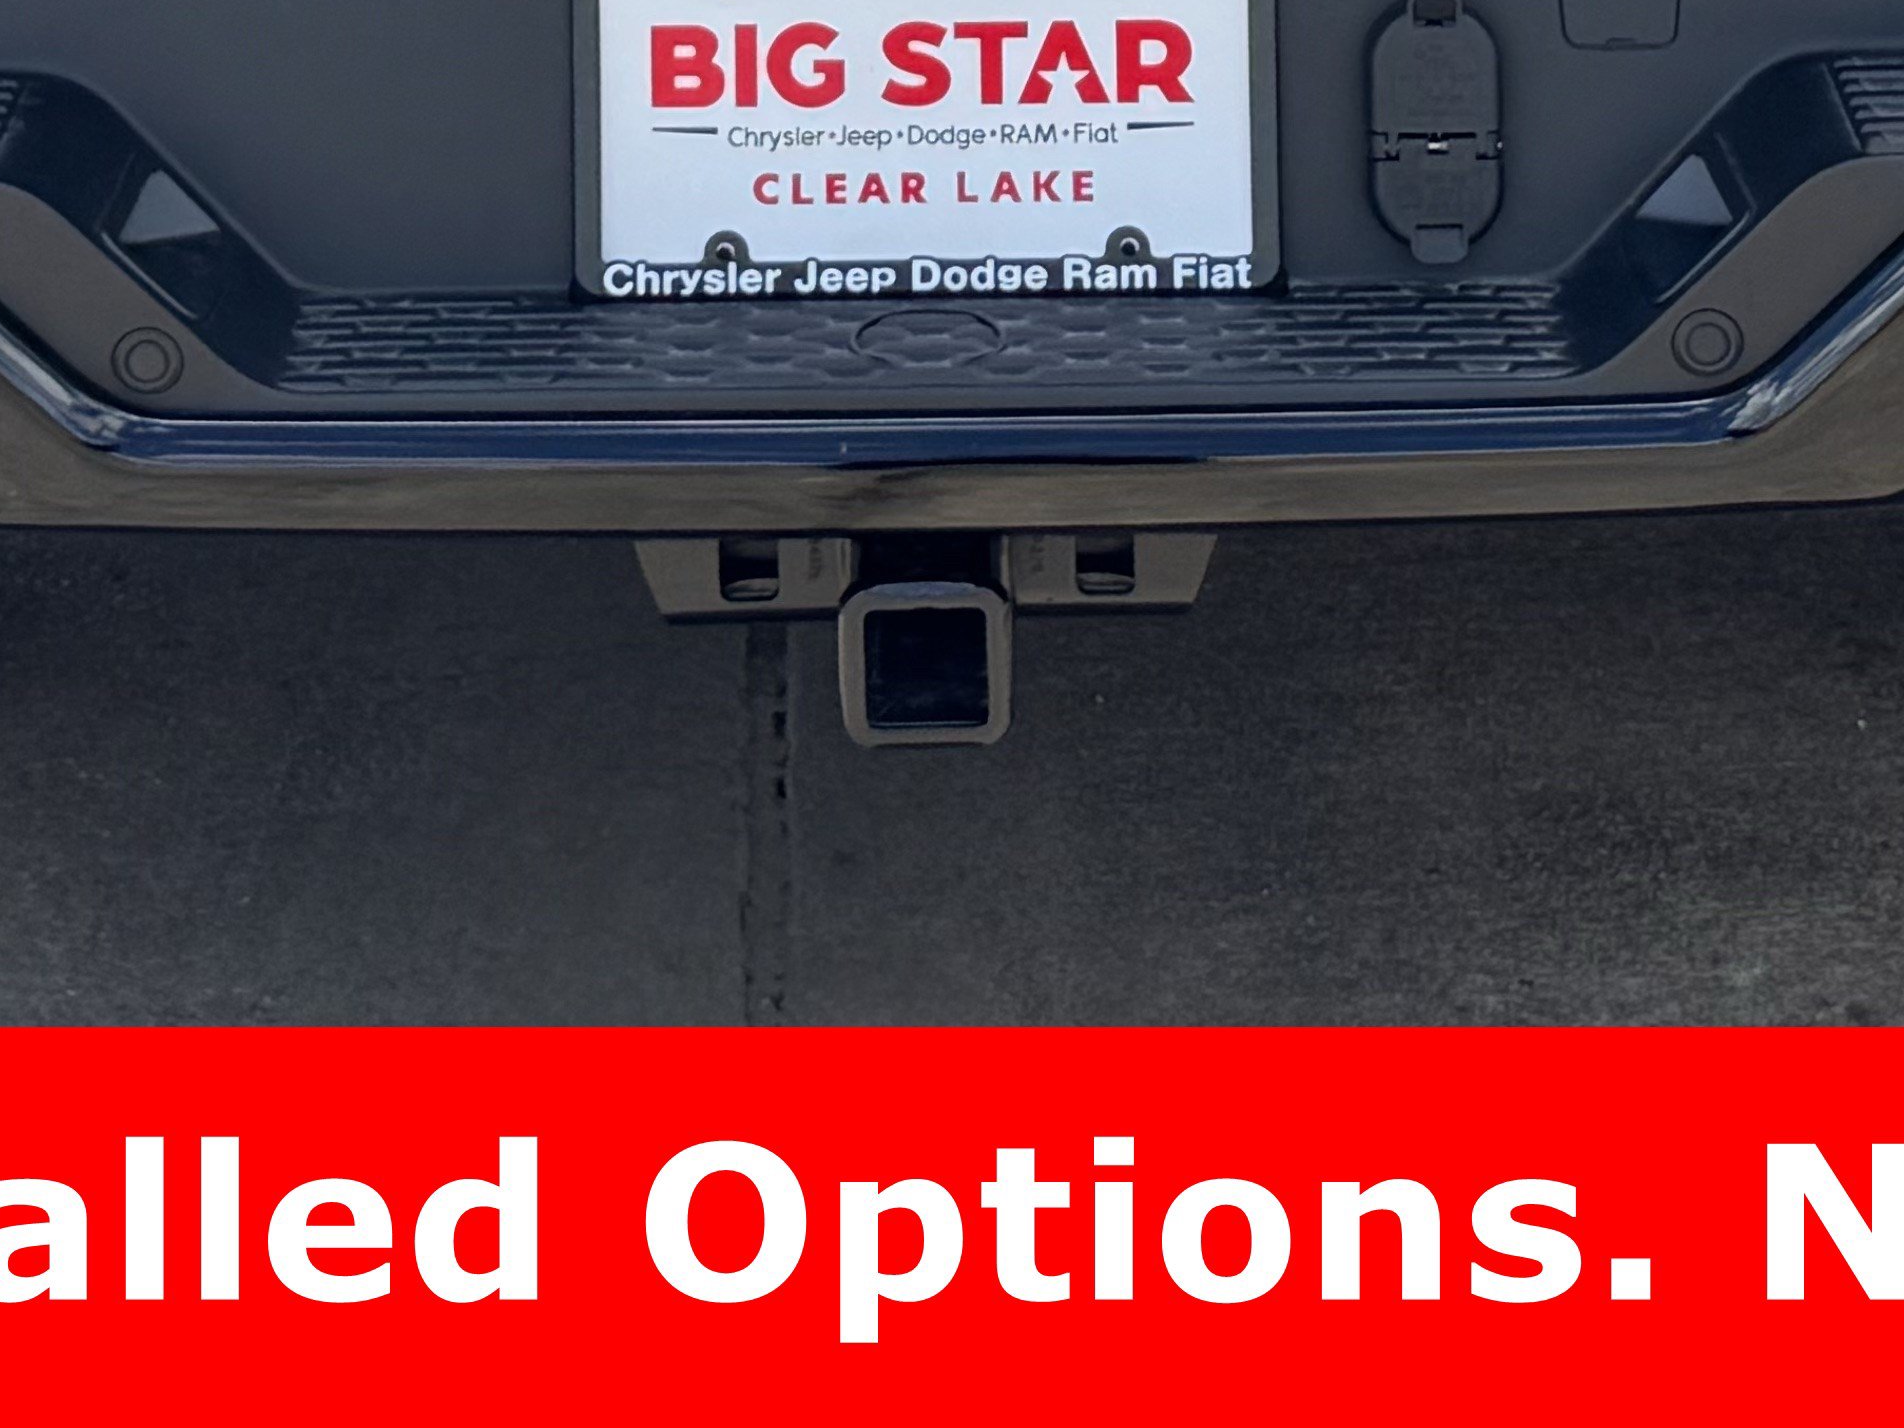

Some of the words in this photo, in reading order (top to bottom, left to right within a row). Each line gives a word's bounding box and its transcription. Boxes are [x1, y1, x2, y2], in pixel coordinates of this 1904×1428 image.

[651, 22, 845, 108] BIG
[881, 19, 1195, 107] STAR
[753, 172, 927, 205] CLEAR
[957, 170, 1094, 204] LAKE
[602, 261, 782, 296] Chrysler
[794, 260, 897, 294] Jeep
[911, 258, 1048, 292] Dodge
[1063, 257, 1157, 290] Ram
[1173, 256, 1252, 289] Fiat
